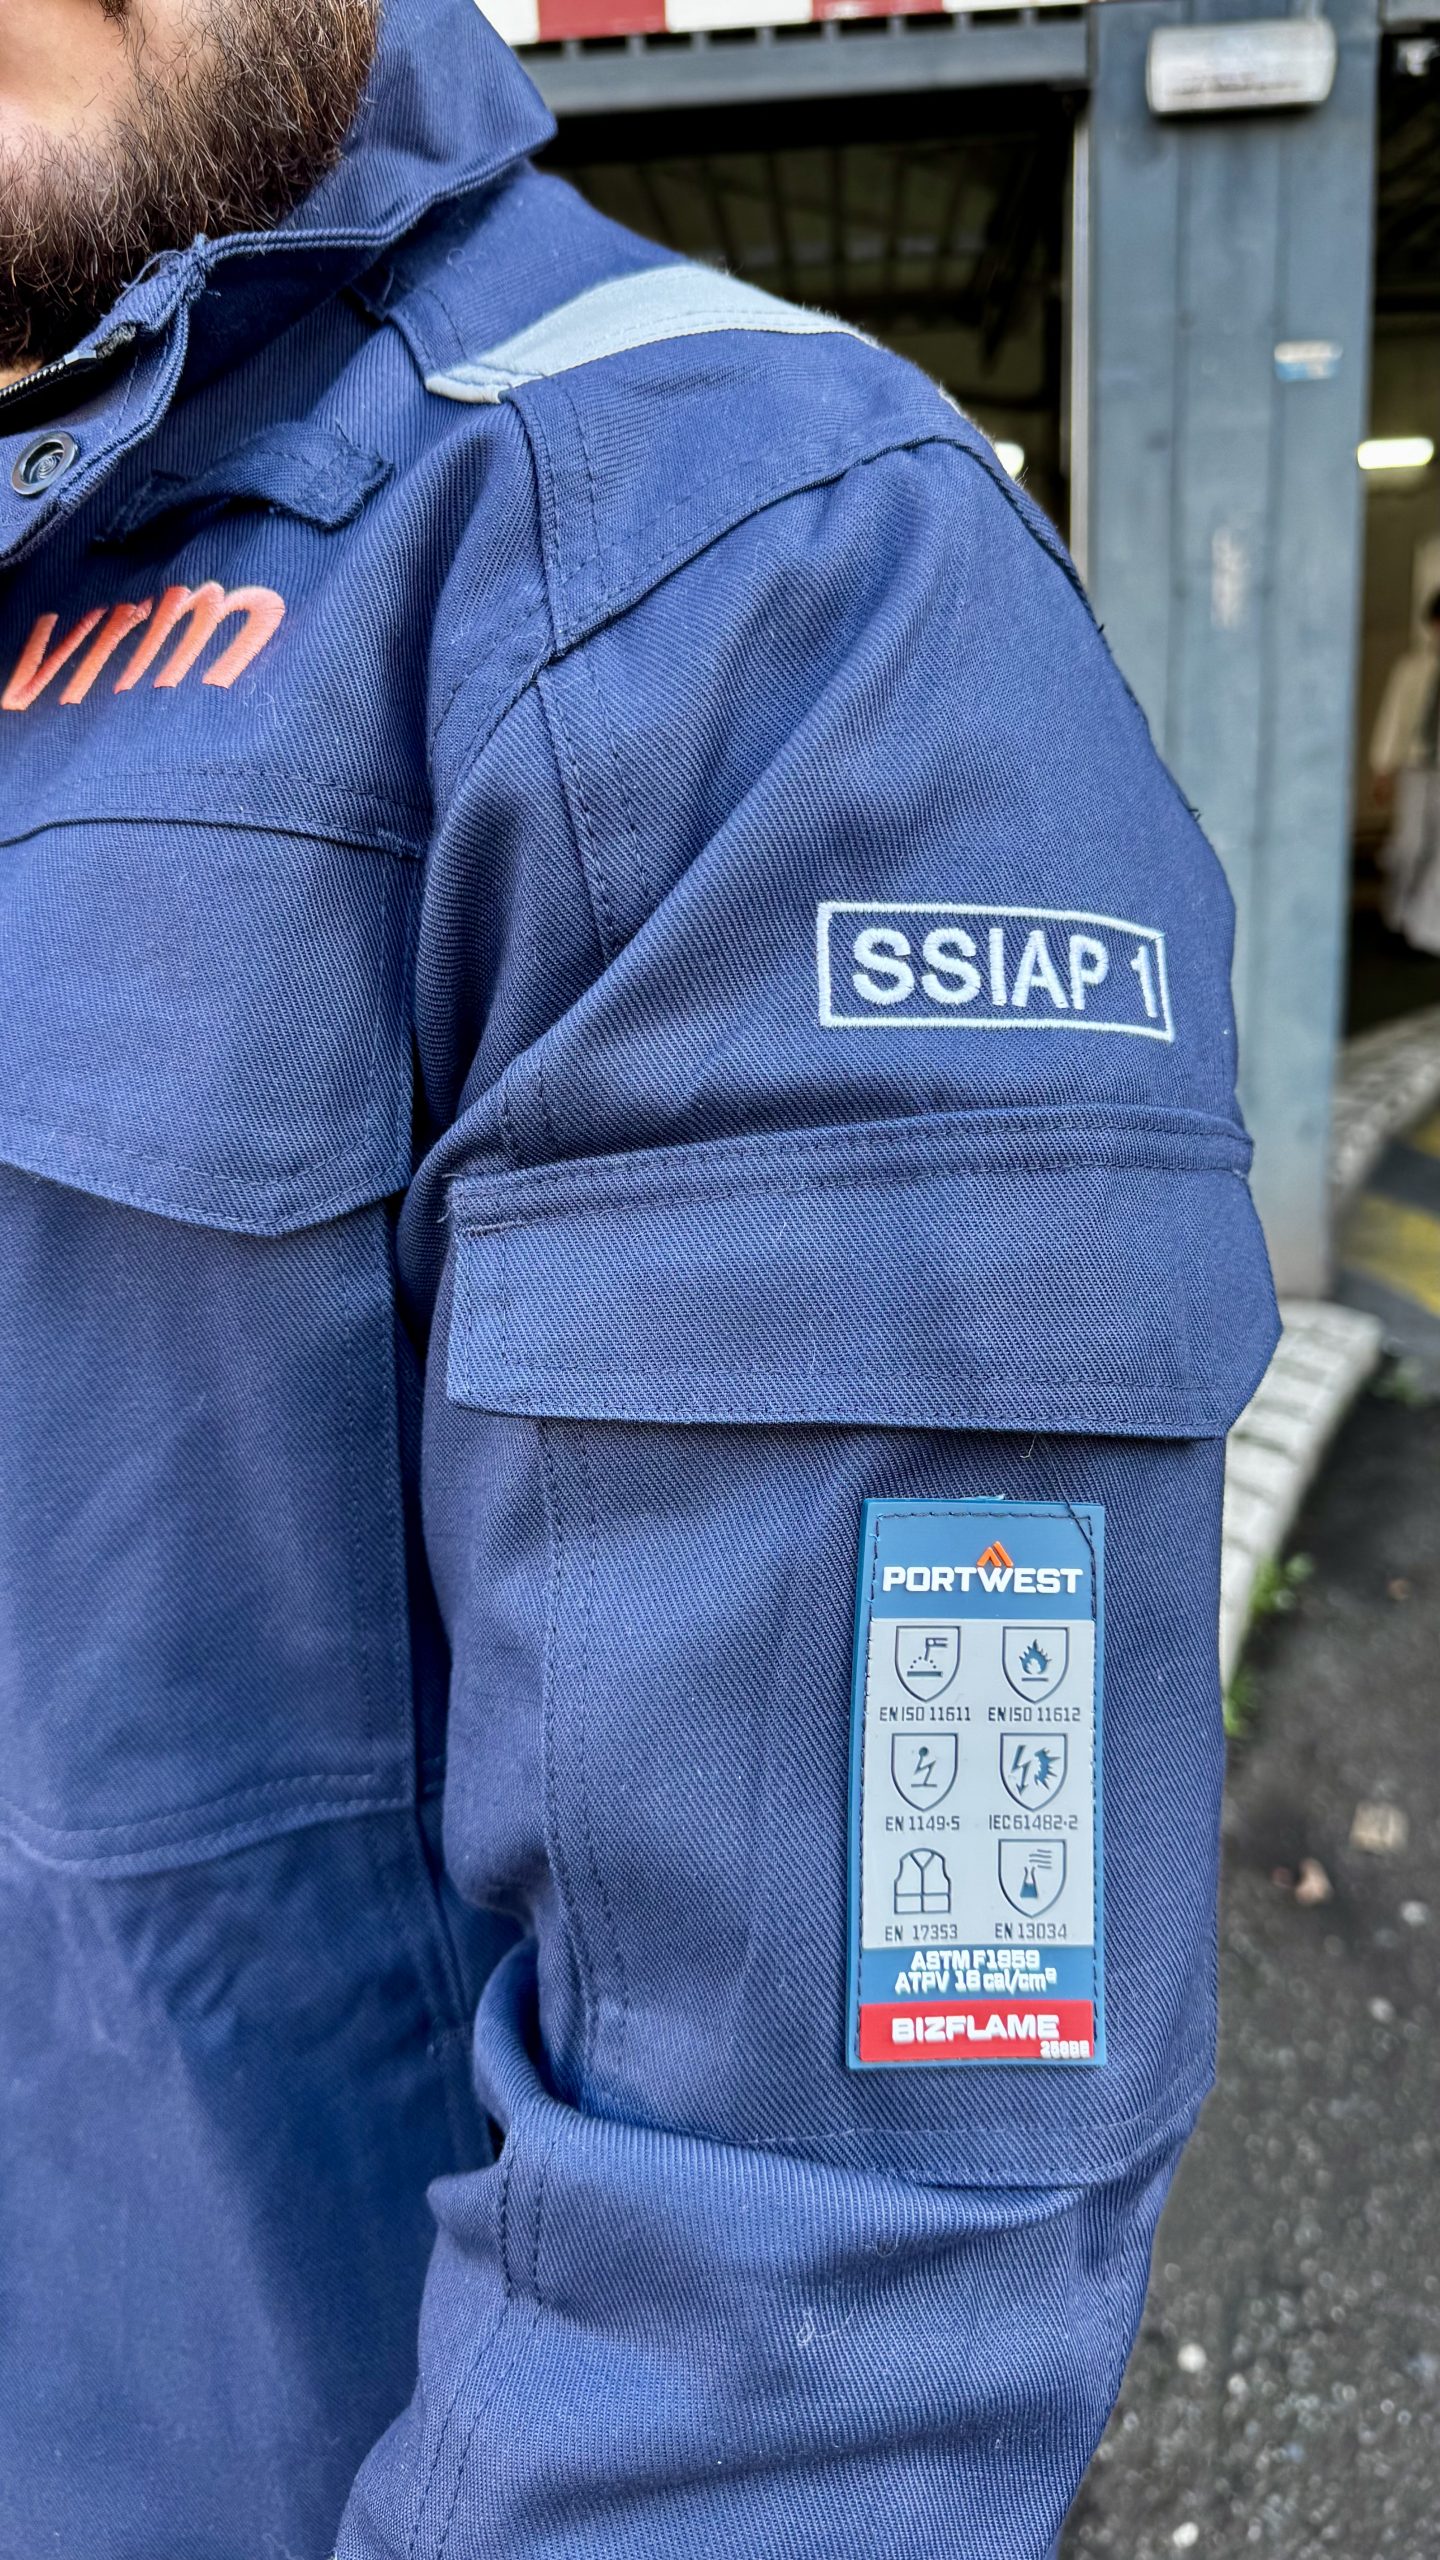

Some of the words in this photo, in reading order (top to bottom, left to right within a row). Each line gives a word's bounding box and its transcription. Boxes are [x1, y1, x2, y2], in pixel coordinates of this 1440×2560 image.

[1, 580, 286, 711] vrm
[852, 927, 1110, 1011] SSIAP
[1130, 944, 1158, 1018] 1
[882, 1566, 1083, 1594] PORTWEST
[880, 1706, 898, 1721] EN
[929, 1706, 971, 1721] 11611
[988, 1707, 1006, 1722] EN
[1037, 1706, 1081, 1721] 11612
[885, 1816, 904, 1831] EN
[885, 1925, 903, 1941] EN
[912, 1924, 958, 1940] 17353
[995, 1923, 1013, 1939] EN
[1017, 1923, 1067, 1939] 13034
[911, 1950, 970, 1971] ASTM
[973, 1949, 1040, 1971] F1959
[894, 1970, 949, 1995] ATPV
[891, 2014, 1059, 2044] BIZFLAME
